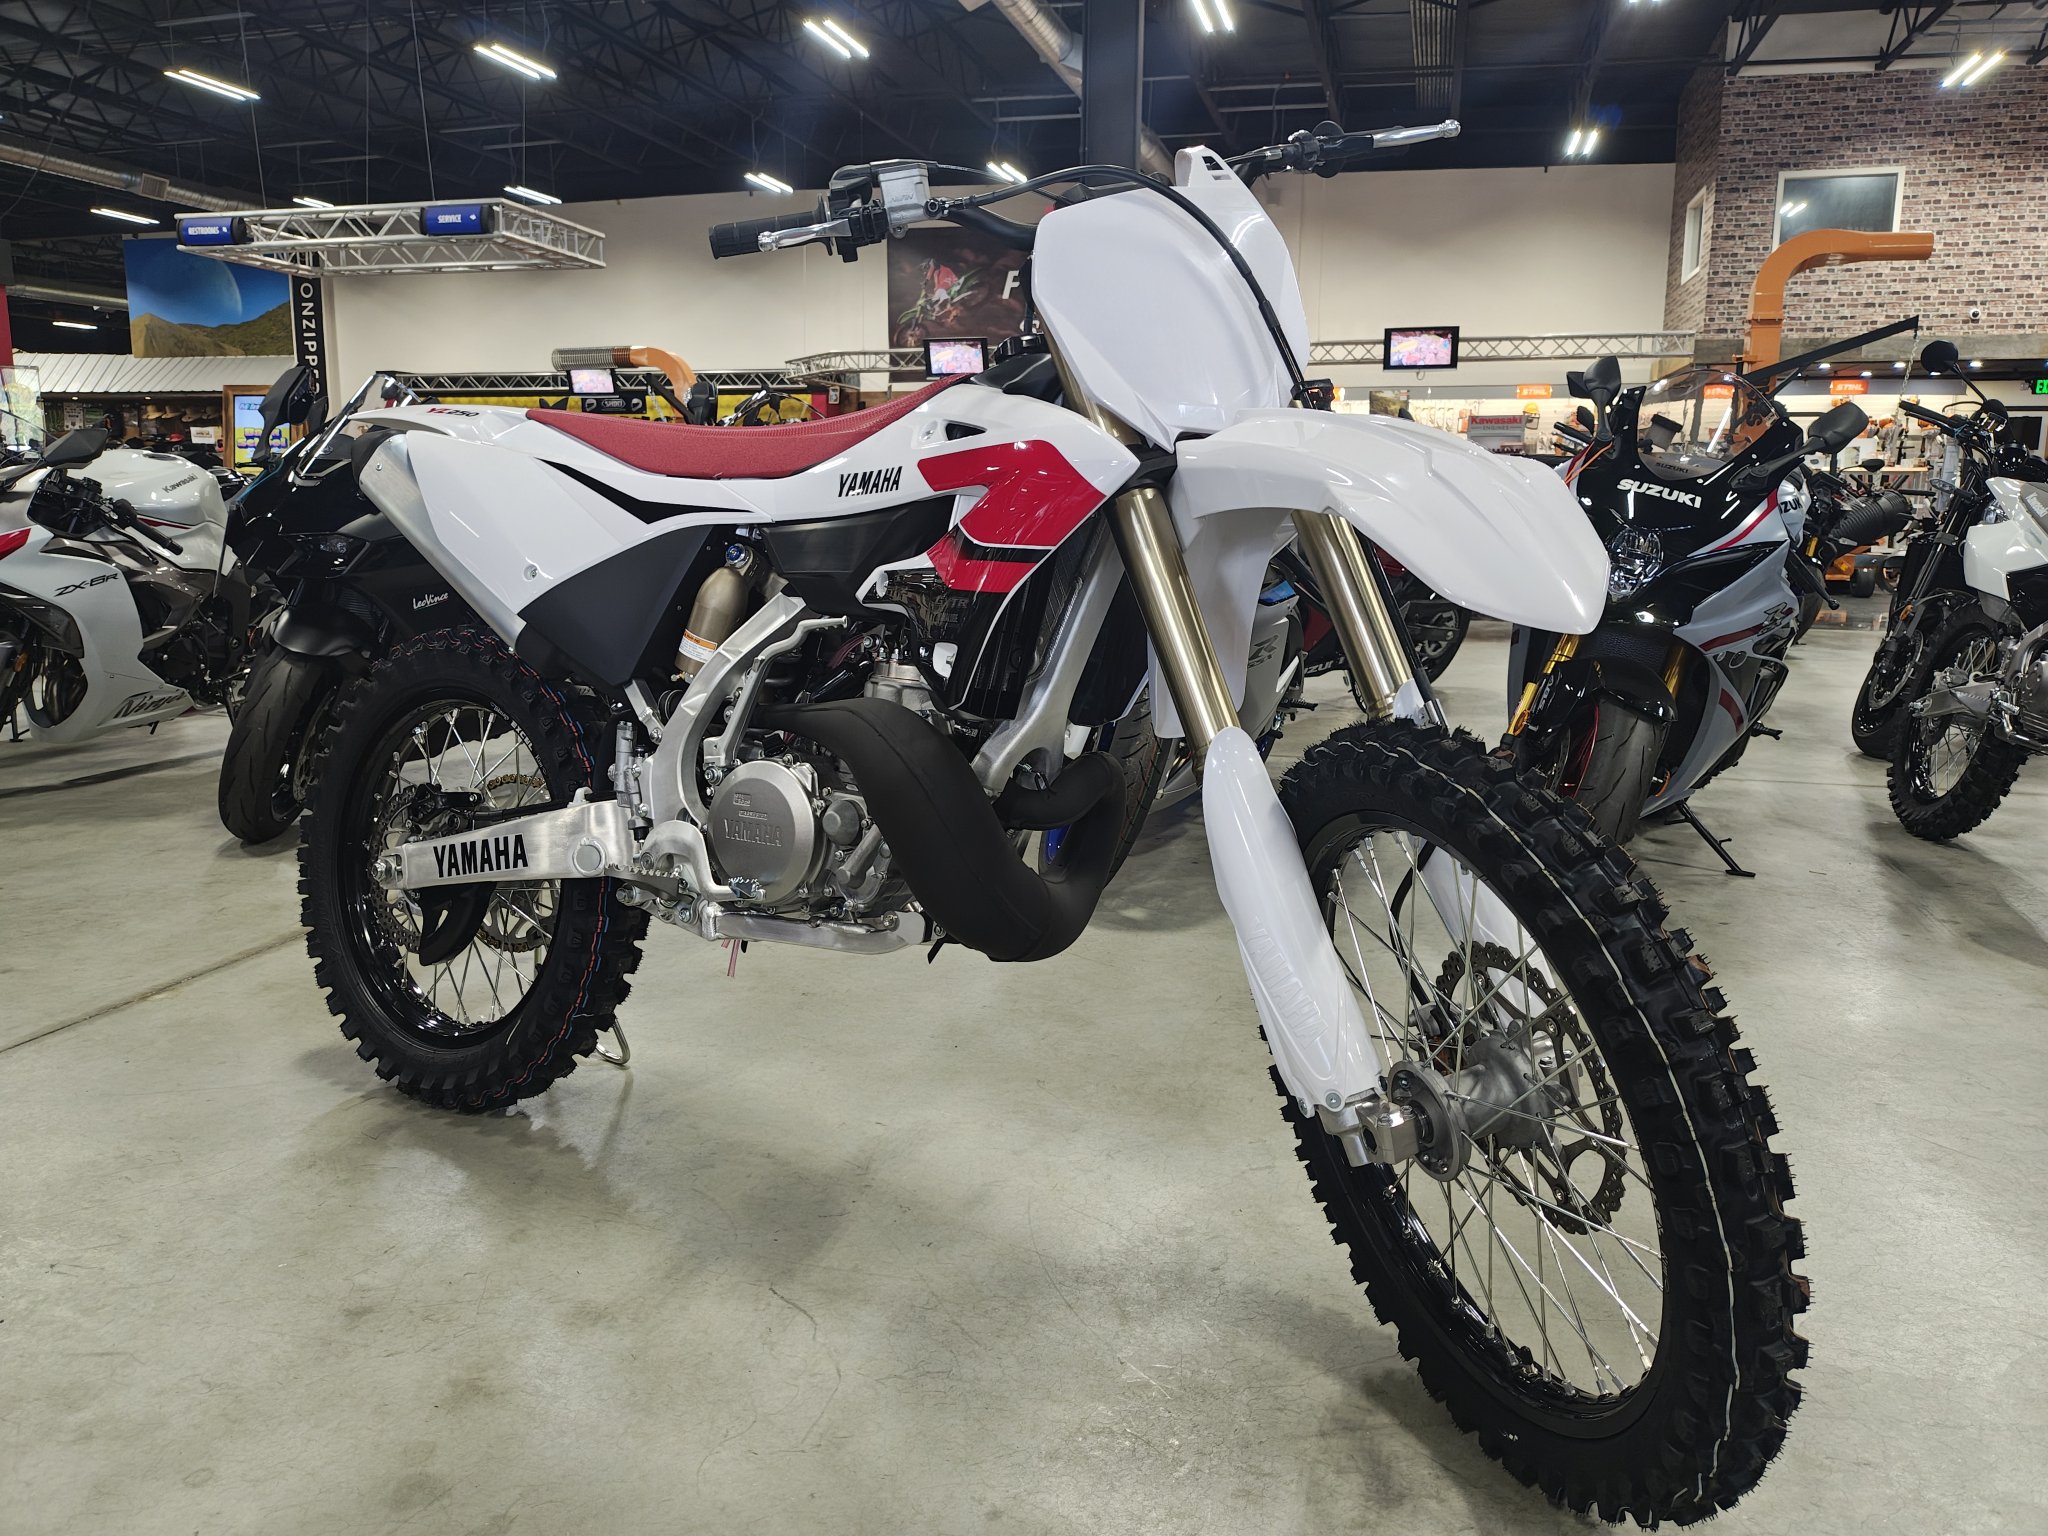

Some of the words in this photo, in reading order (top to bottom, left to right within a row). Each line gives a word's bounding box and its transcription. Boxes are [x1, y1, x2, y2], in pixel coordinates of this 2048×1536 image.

[437, 214, 461, 224] SERVICE
[188, 226, 219, 235] RESTROOMS
[1836, 383, 1864, 391] STIHL
[1471, 416, 1523, 425] Kawasaki
[1656, 462, 1689, 474] SUZUKI
[162, 473, 198, 493] Kawasaki
[838, 466, 903, 497] YAMAHA
[1617, 479, 1702, 508] SUZUKI
[54, 573, 119, 597] ZX-6R
[413, 592, 448, 609] LeoVince
[510, 720, 533, 751] EXCEL
[433, 834, 529, 878] YAMAHA
